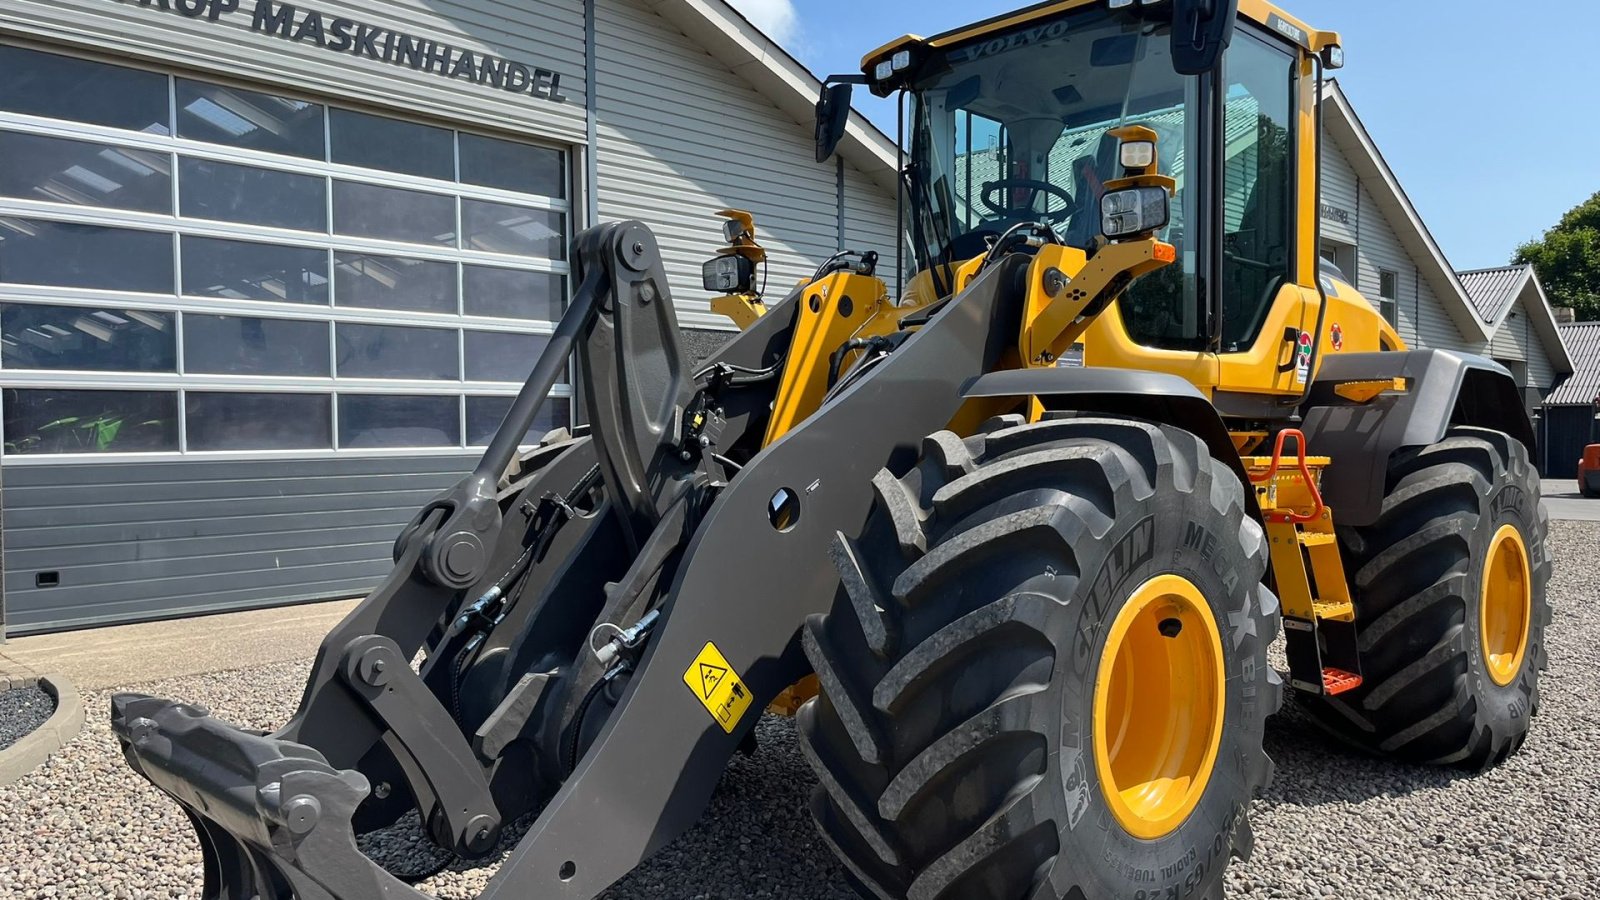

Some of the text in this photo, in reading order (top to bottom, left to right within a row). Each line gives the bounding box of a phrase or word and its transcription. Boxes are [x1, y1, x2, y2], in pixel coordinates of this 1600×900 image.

[252, 0, 567, 102] MASKINHANDEL
[965, 20, 1069, 60] VOLVO
[1184, 520, 1239, 597] MEGA
[1227, 591, 1257, 652] X
[1160, 845, 1197, 881] RADIAL
